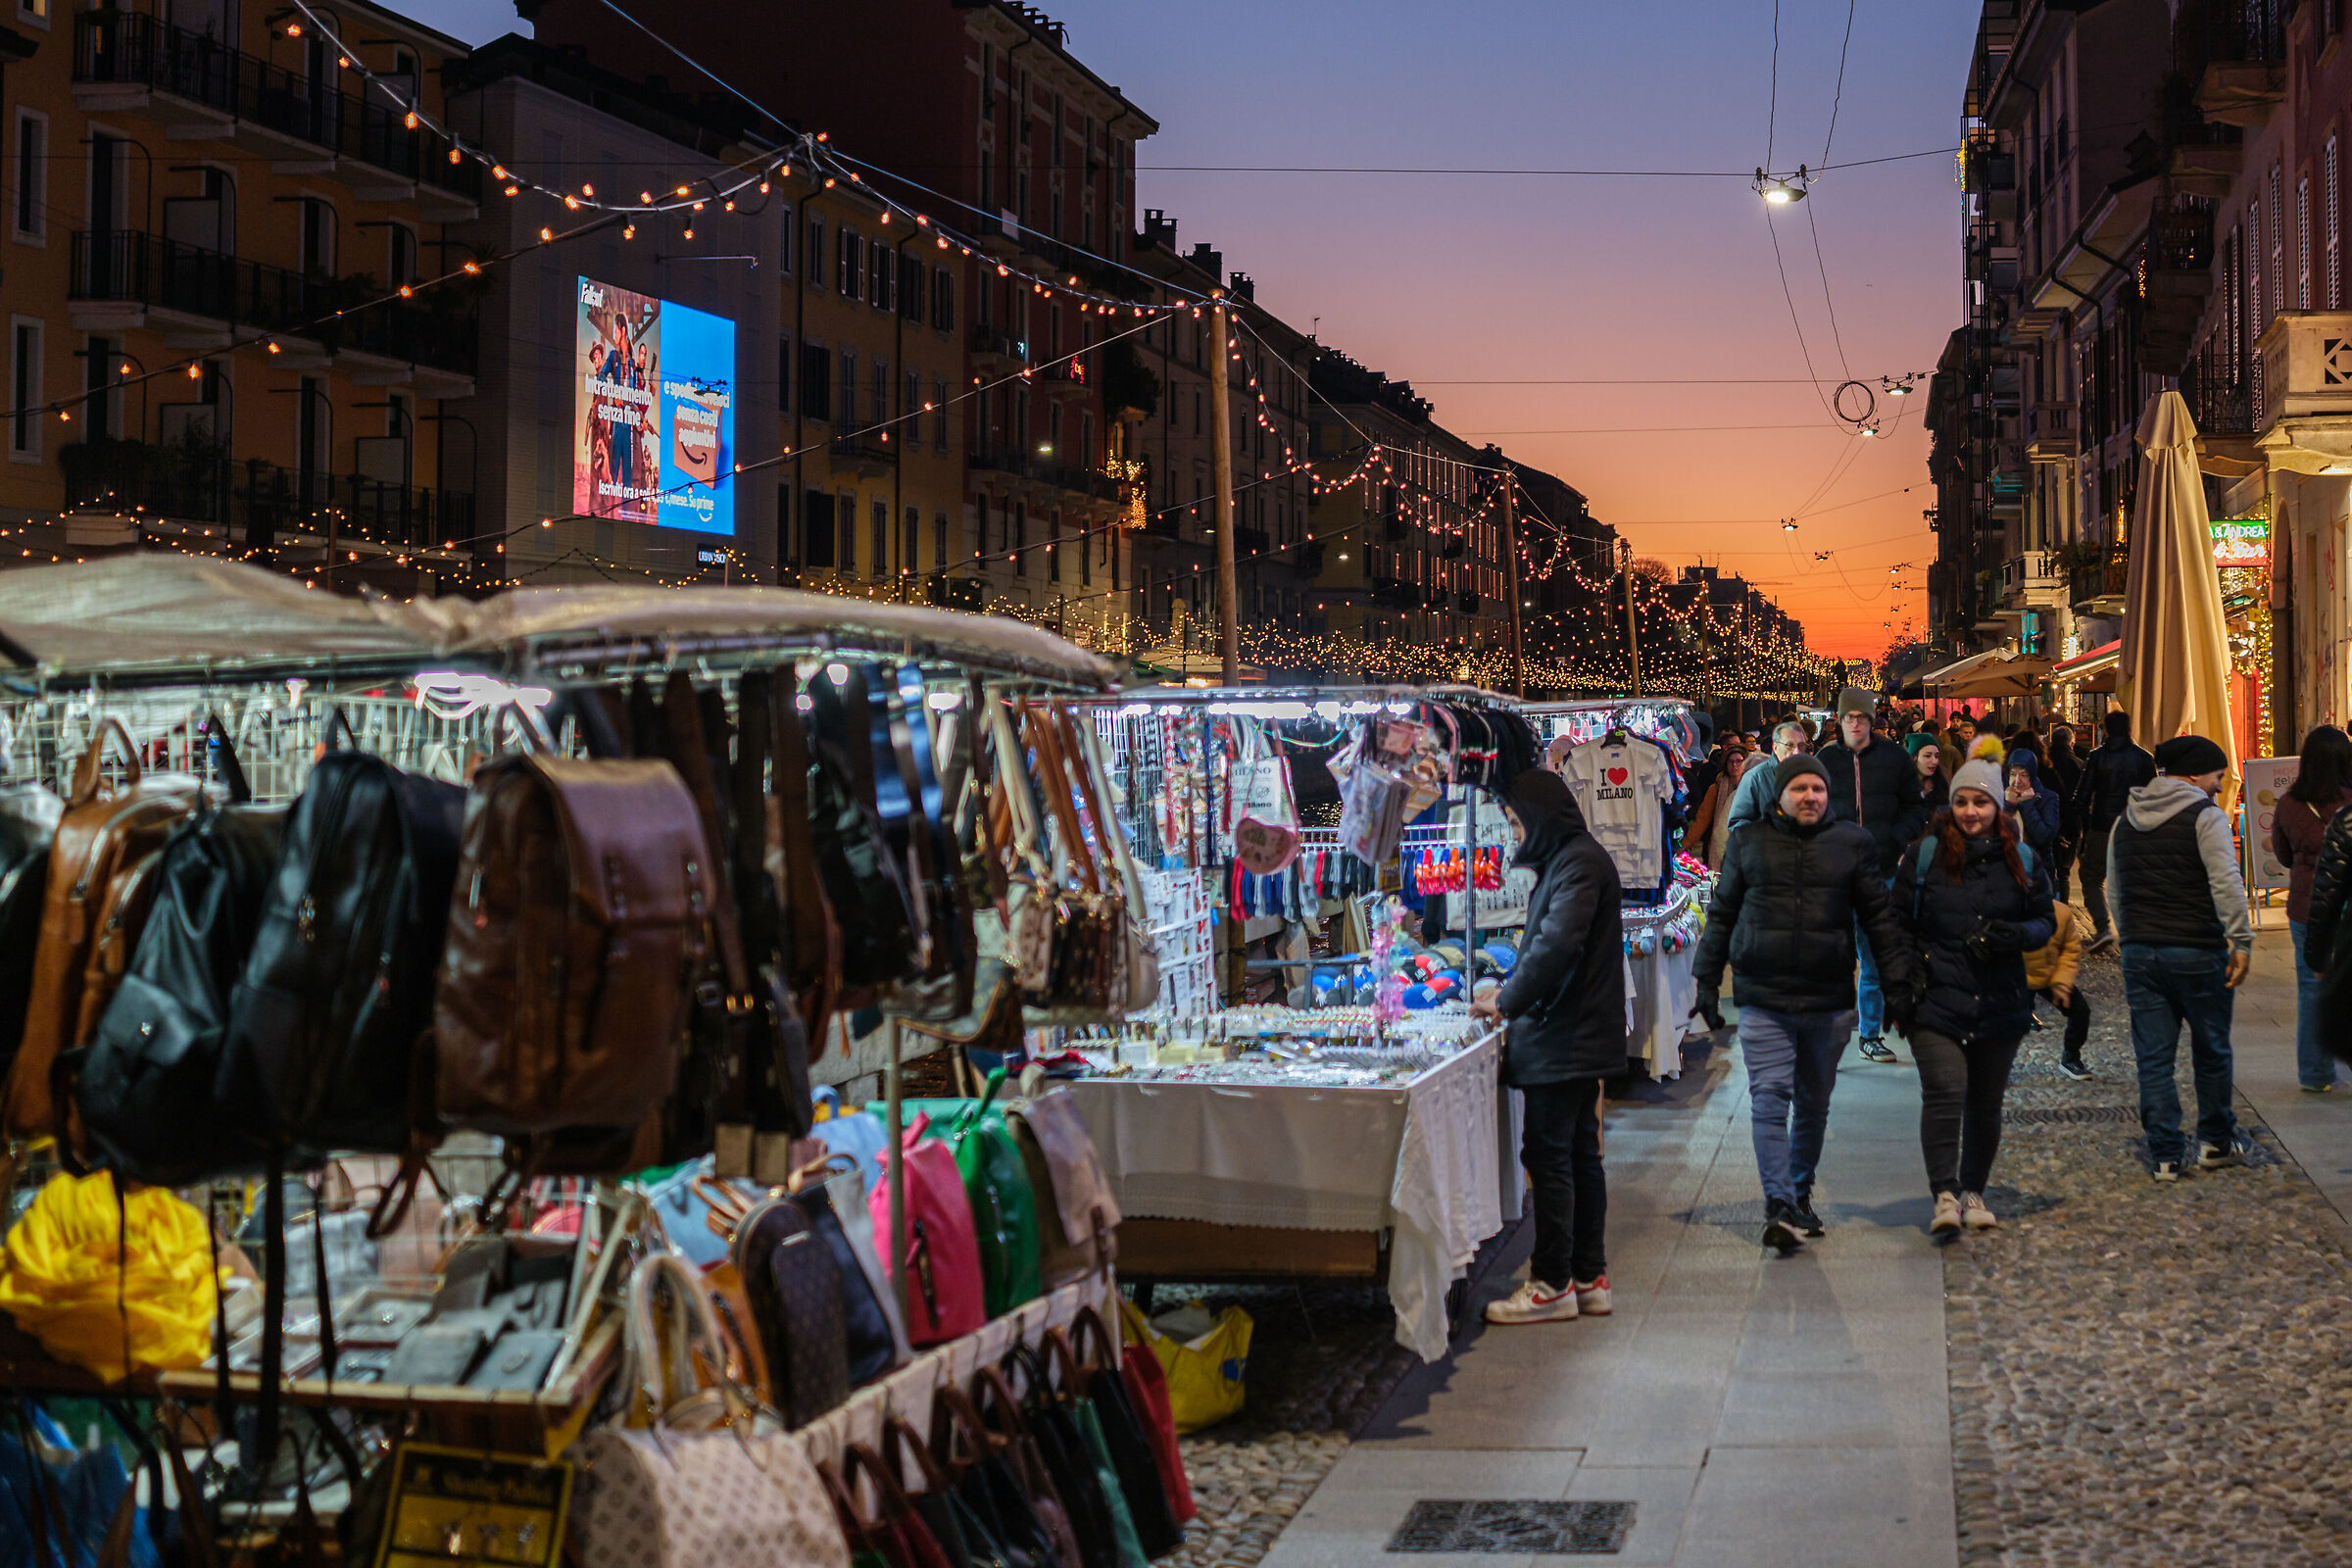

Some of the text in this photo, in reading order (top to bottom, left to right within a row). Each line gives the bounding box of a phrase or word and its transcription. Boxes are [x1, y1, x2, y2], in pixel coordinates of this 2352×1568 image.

[585, 373, 653, 406] Intrattenimento
[598, 404, 641, 426] senza fine
[676, 405, 718, 428] senza costi
[678, 426, 716, 449] aggiuntivi
[599, 479, 623, 498] Iscriviti
[623, 486, 634, 500] ora
[697, 496, 714, 512] prime
[2223, 525, 2266, 538] ANDREA
[1600, 768, 1607, 786] I
[1596, 787, 1634, 801] MILANO
